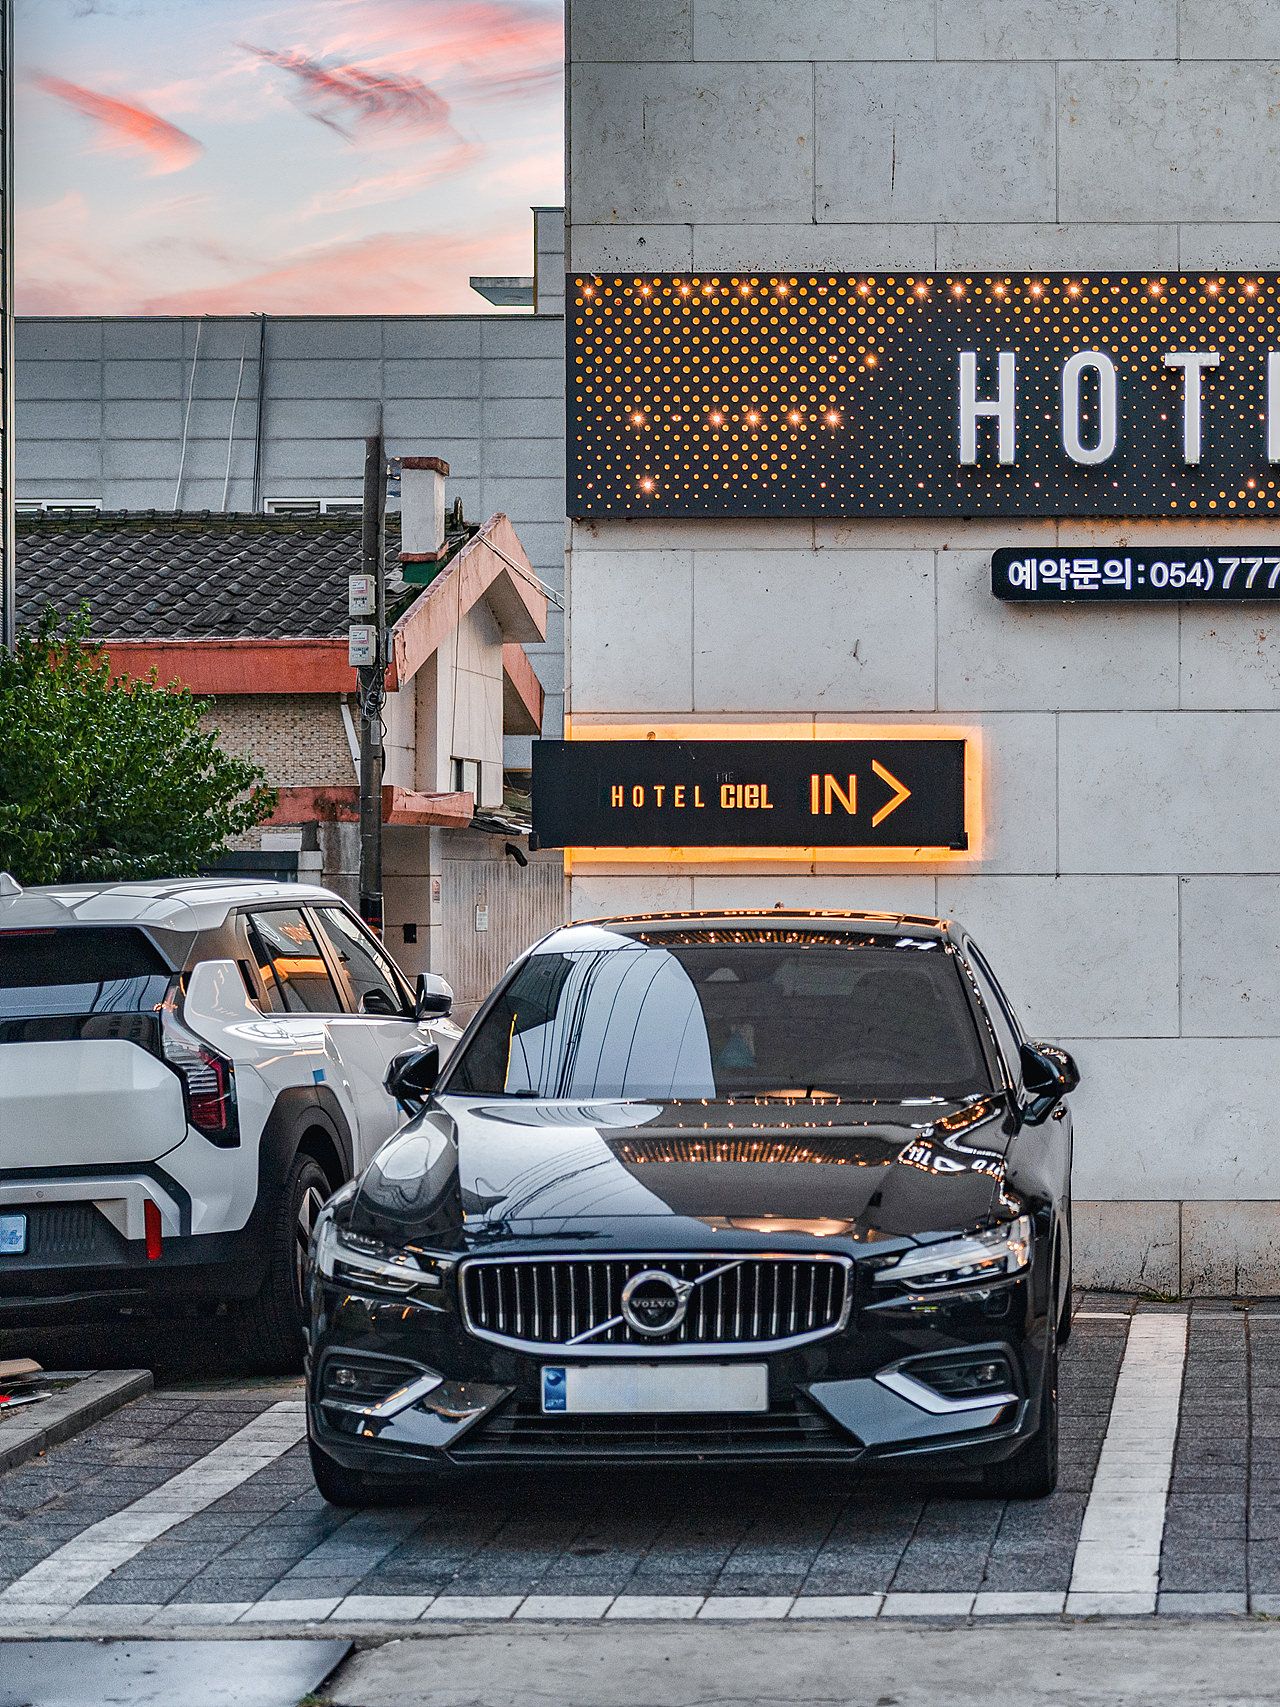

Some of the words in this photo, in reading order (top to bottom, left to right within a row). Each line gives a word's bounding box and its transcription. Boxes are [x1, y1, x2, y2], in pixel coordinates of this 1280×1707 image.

[611, 785, 705, 808] HOTEL
[811, 773, 857, 815] IN
[631, 1299, 676, 1308] VOLVO
